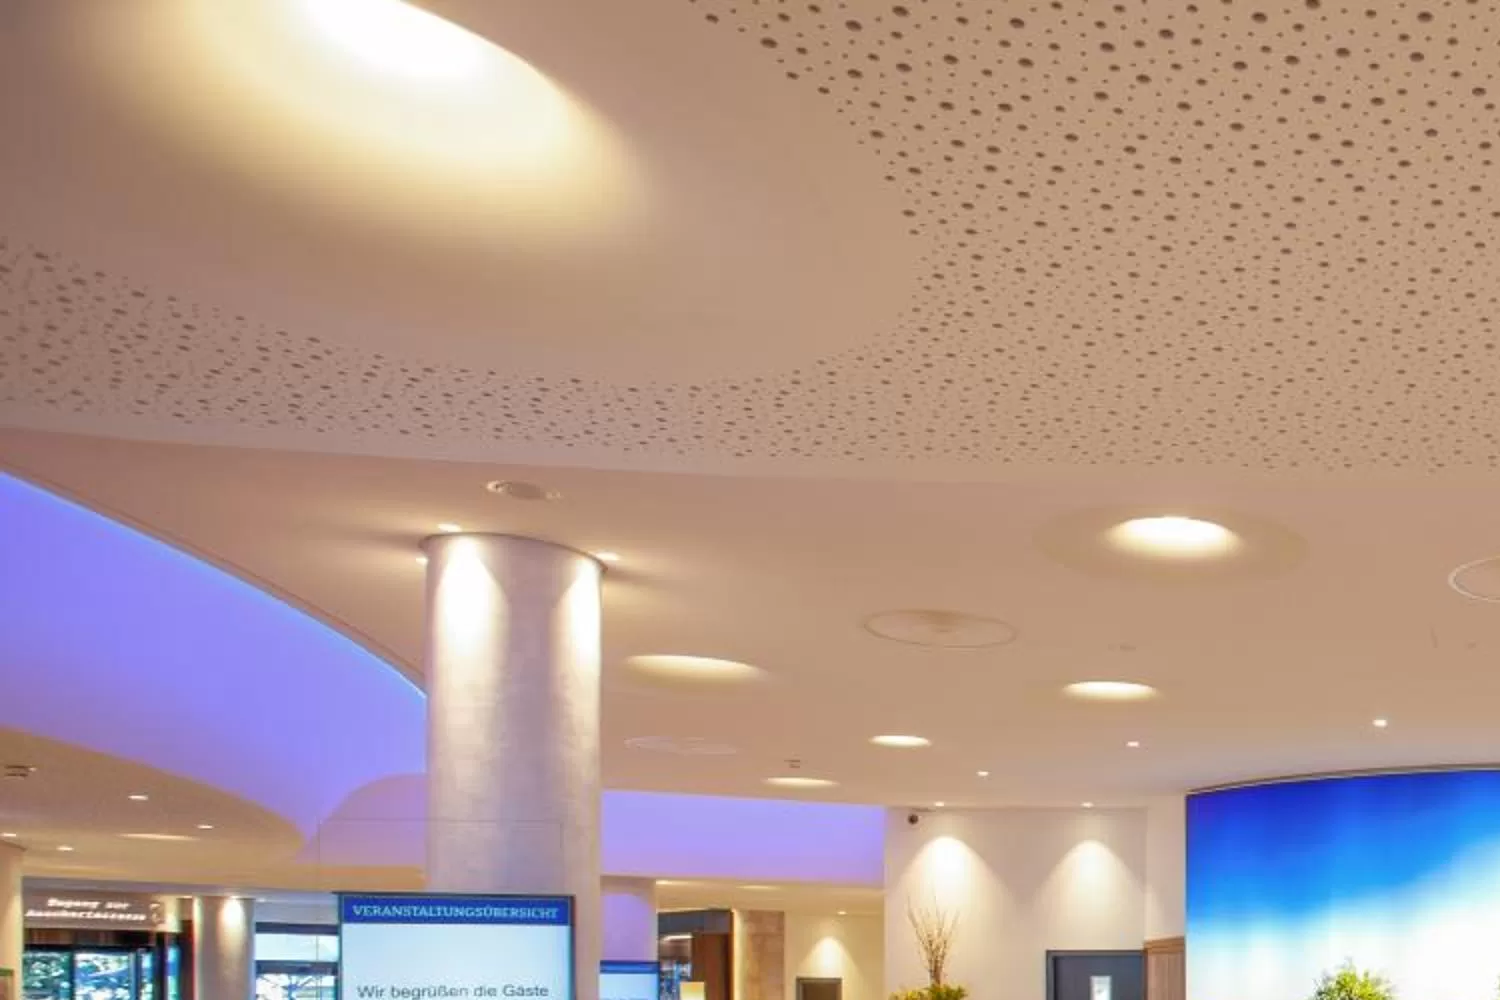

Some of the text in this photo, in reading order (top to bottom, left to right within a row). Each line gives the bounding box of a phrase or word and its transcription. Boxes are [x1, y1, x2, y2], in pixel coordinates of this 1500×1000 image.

[352, 904, 559, 920] VERANSTALTUNGSÜBERSICHT
[357, 983, 549, 1000] Wir begrüßen die Gäste
